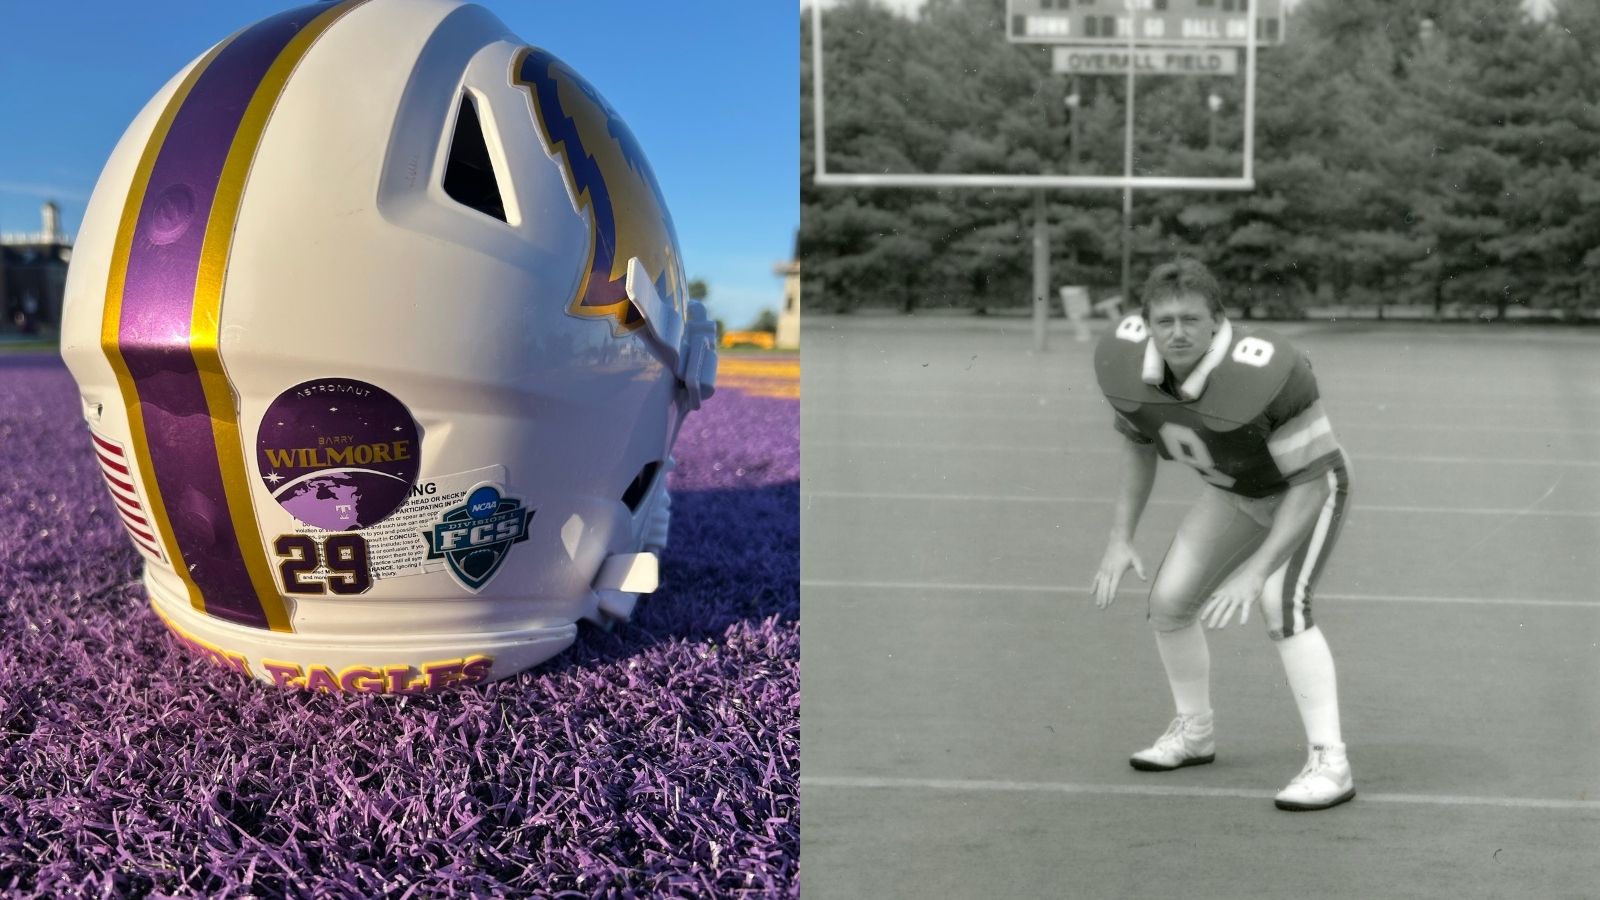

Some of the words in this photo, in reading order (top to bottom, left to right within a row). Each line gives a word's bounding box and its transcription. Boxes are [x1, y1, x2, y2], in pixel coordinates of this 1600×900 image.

[1068, 54, 1156, 70] OVERALL
[1166, 54, 1221, 70] FIELD
[297, 384, 371, 399] ASTRONAUT
[318, 435, 354, 445] BARRY
[264, 439, 411, 469] WILMORE
[411, 498, 430, 506] HEAD
[441, 492, 460, 501] NECK
[472, 500, 497, 513] NCAA
[448, 514, 506, 530] DIVISION
[440, 517, 520, 551] FCS
[272, 534, 370, 596] 29
[262, 654, 495, 695] EAGLES
